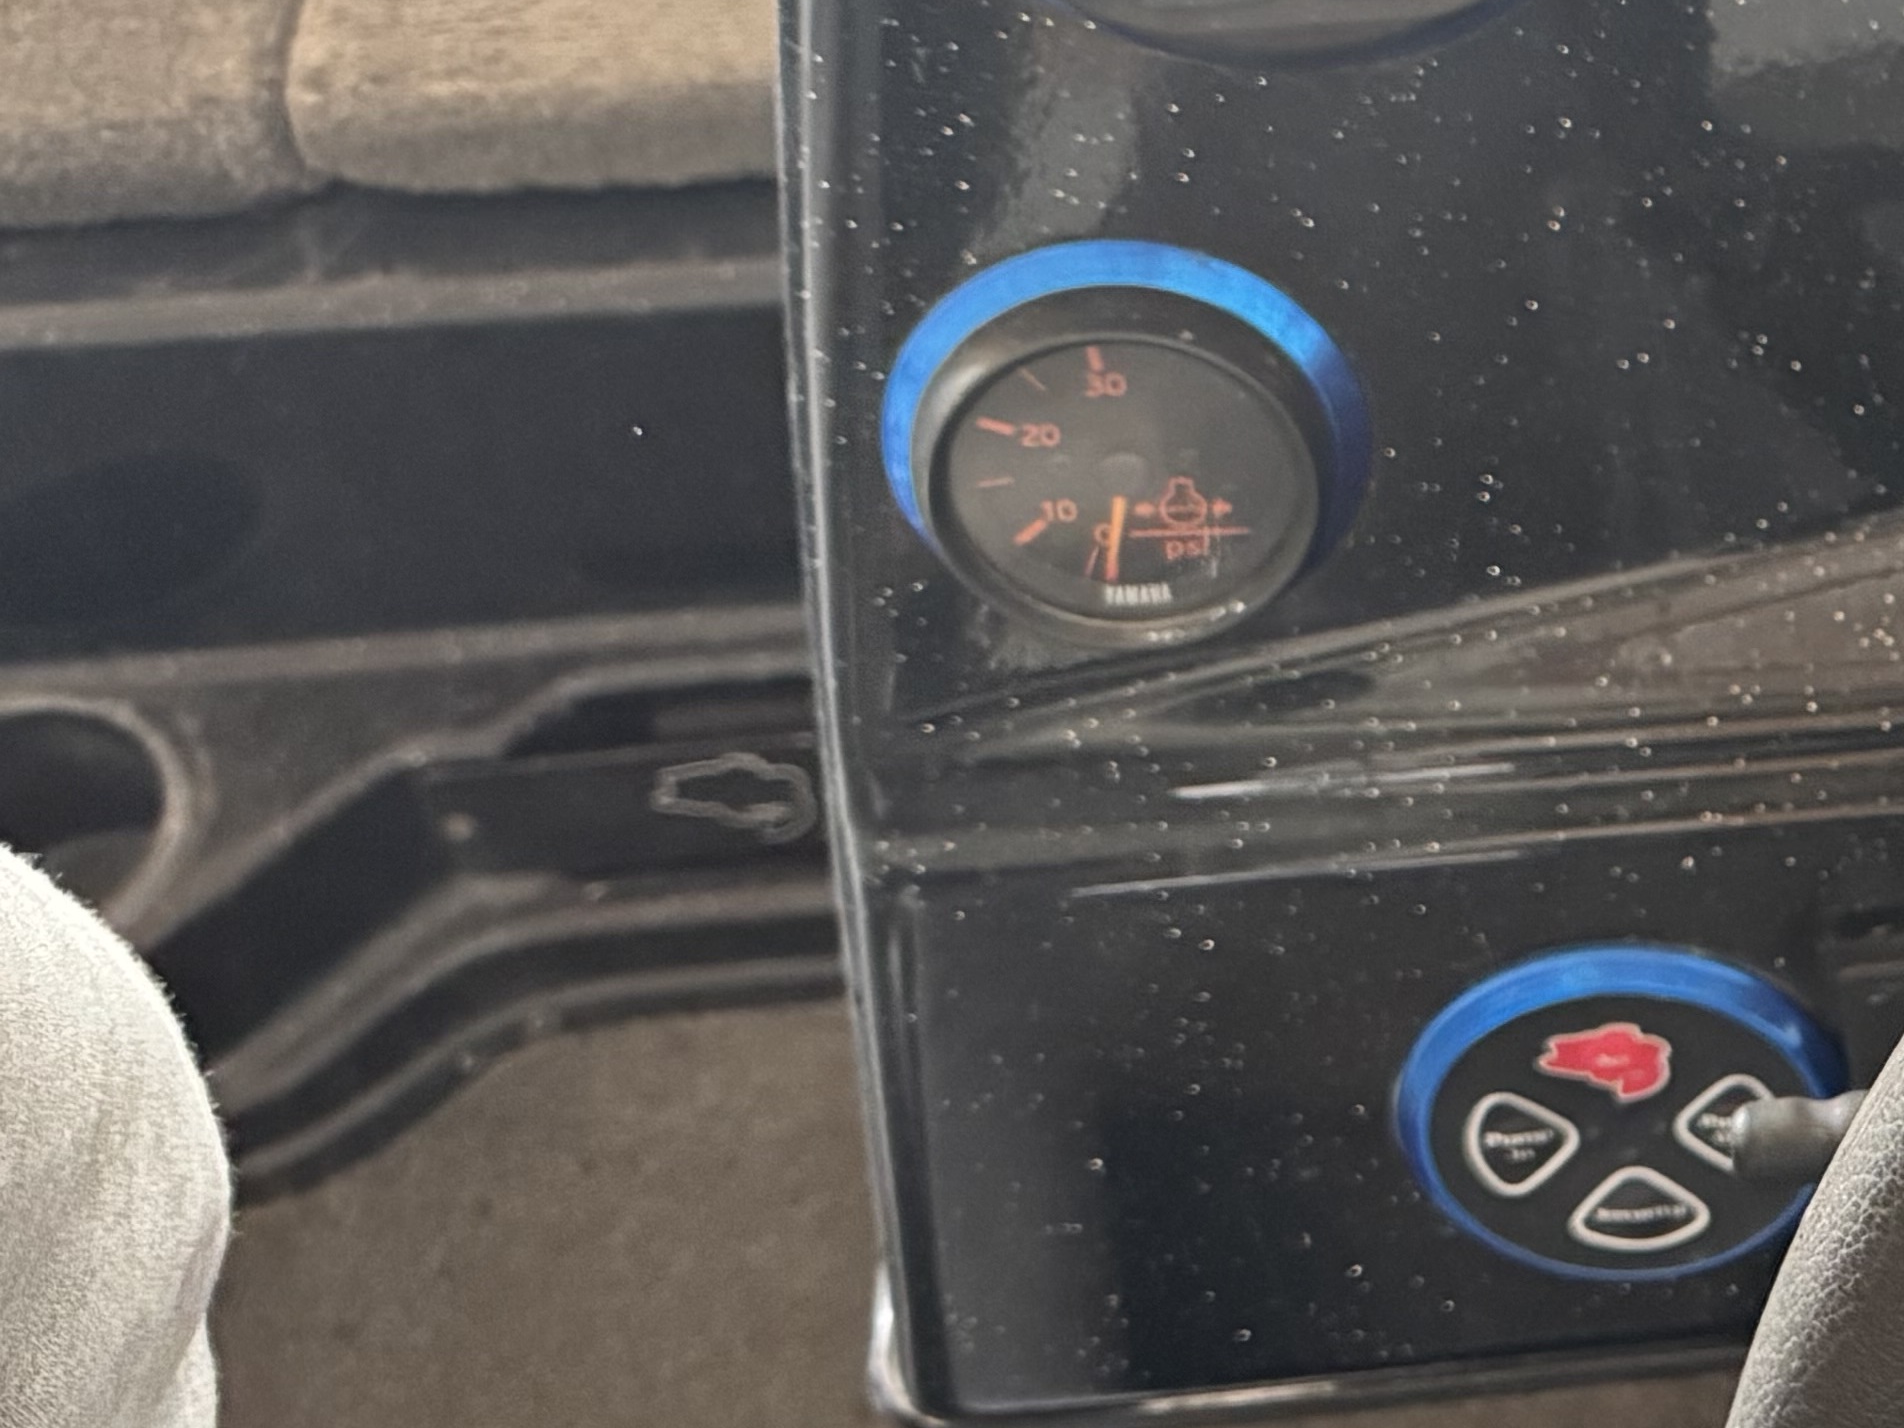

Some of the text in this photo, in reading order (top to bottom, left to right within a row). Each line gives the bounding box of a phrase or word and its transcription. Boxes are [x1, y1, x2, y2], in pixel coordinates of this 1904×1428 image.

[1020, 423, 1062, 448] 20
[1041, 498, 1079, 523] 10
[1105, 582, 1173, 606] YAMAHA
